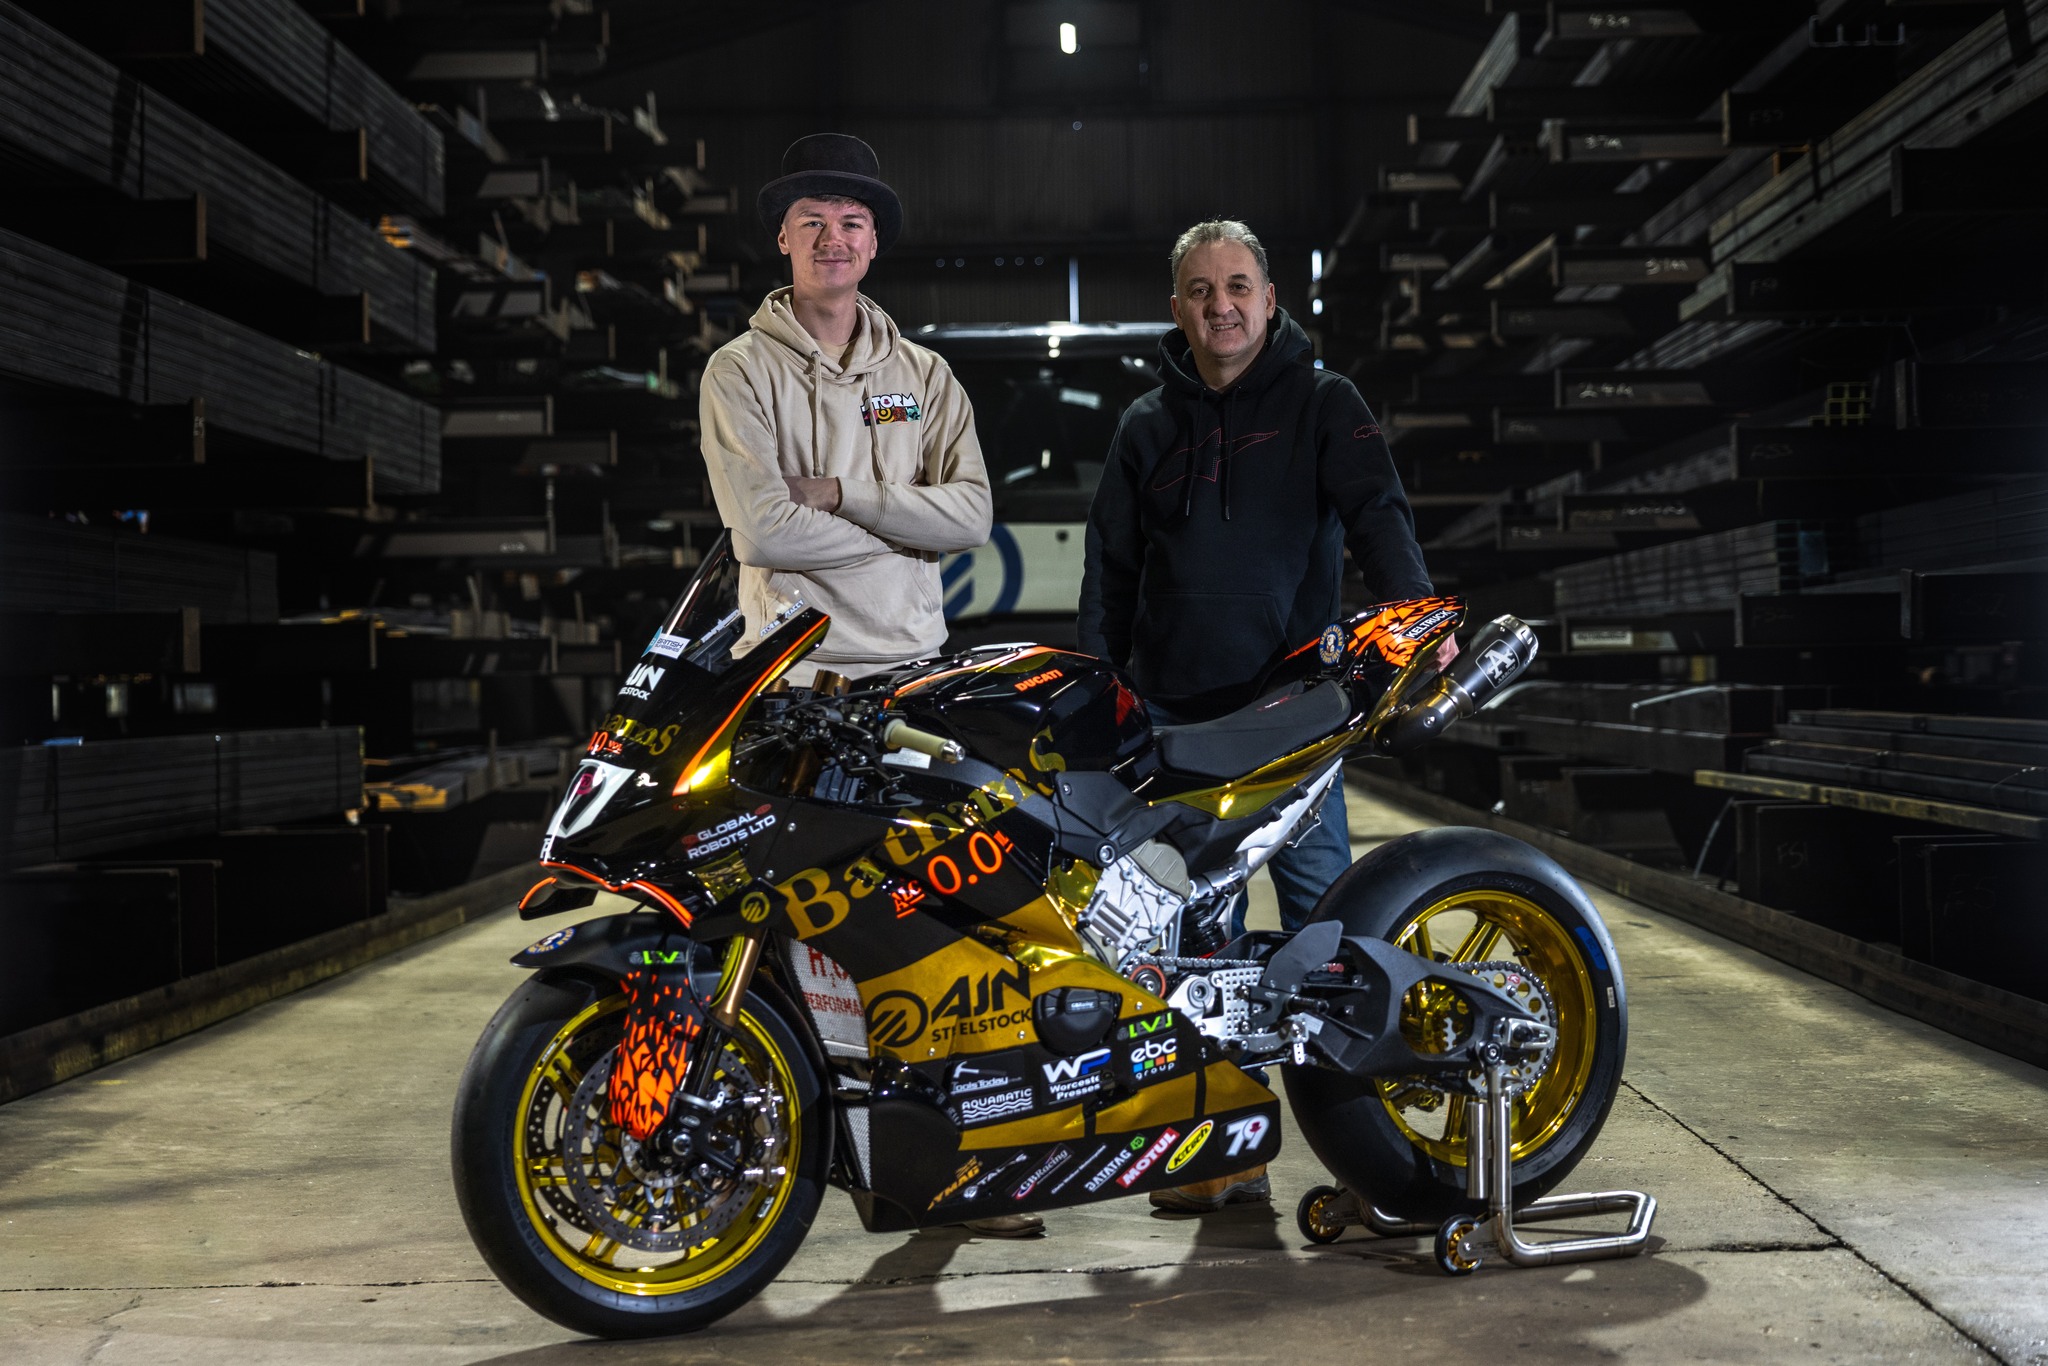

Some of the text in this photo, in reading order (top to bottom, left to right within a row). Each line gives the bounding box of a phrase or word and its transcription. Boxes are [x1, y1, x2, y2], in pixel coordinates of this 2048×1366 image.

[1406, 608, 1451, 638] KELTRUCK
[656, 637, 685, 649] BRITISH
[1014, 668, 1064, 692] DUCATI
[1498, 665, 1516, 684] ARROW
[687, 814, 776, 859] ROBOTS LTD
[697, 813, 758, 841] GLOBAL
[931, 961, 1031, 1025] AJN
[1131, 1038, 1177, 1063] ebc
[1135, 1062, 1175, 1081] group
[962, 1088, 1033, 1111] AQUAMATIC
[1226, 1114, 1270, 1157] 79
[1020, 1150, 1068, 1191] GBRacing
[1123, 1131, 1177, 1185] MOTUL
